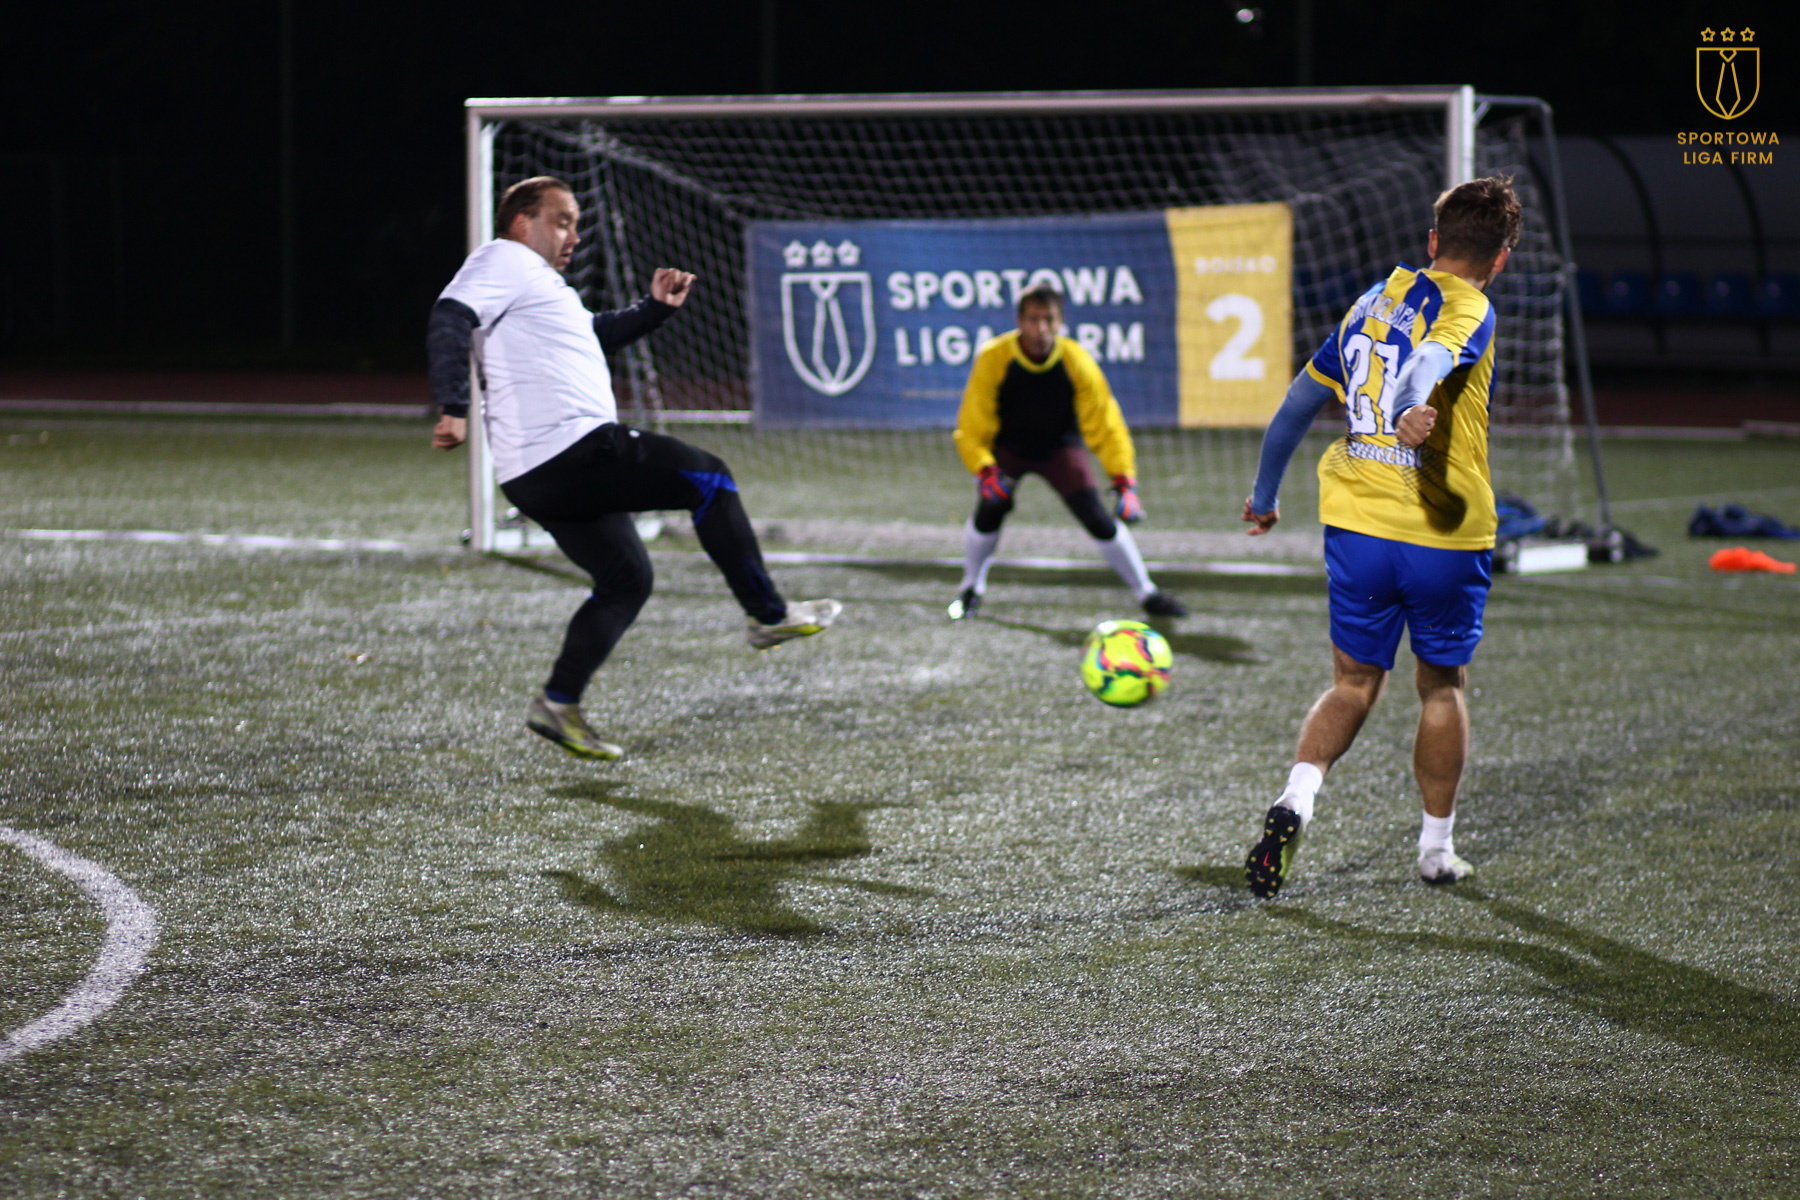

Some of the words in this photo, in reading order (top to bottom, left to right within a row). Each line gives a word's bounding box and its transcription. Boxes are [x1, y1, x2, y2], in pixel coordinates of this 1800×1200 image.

[1195, 255, 1277, 274] BOISKO
[1058, 321, 1145, 363] RM
[1205, 293, 1265, 380] 2
[1343, 333, 1400, 435] 27
